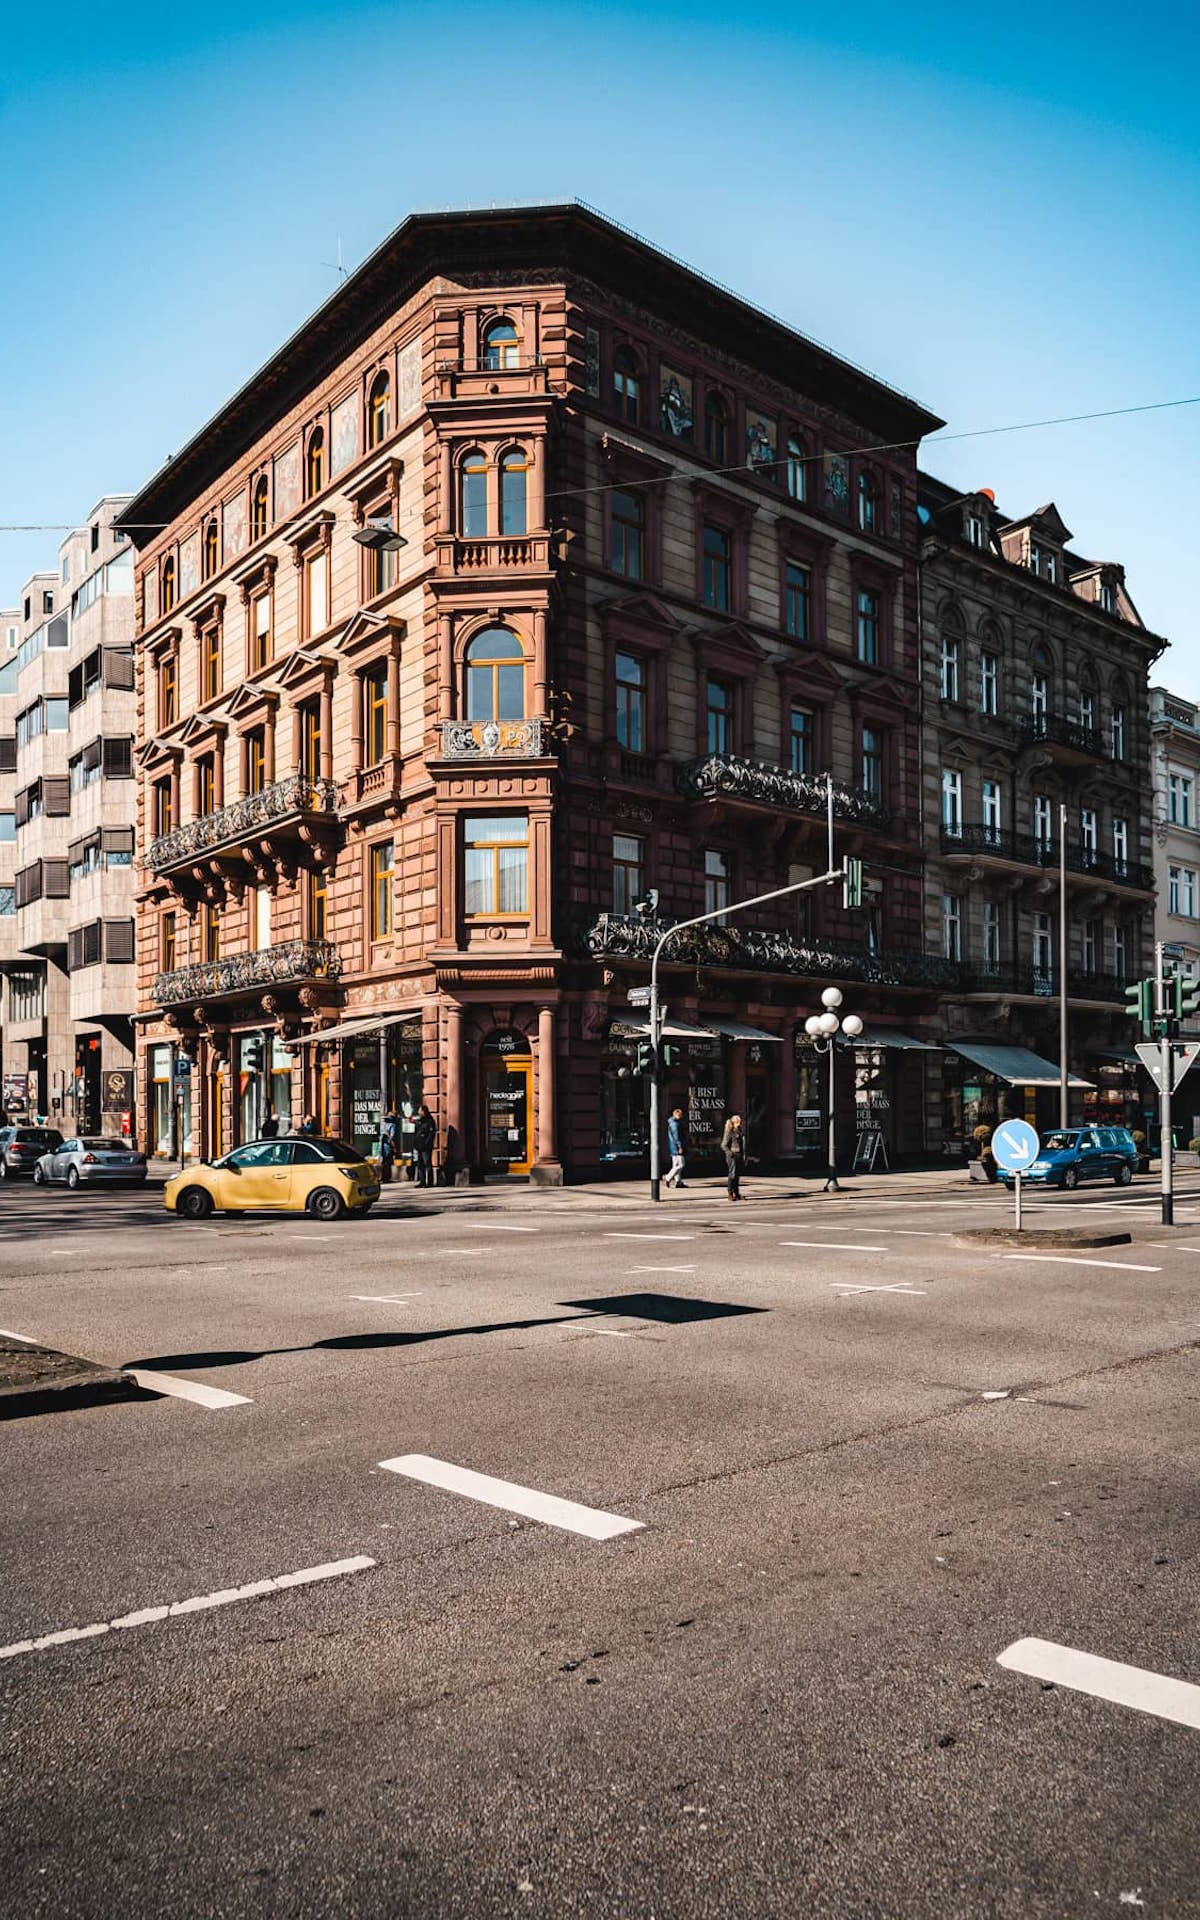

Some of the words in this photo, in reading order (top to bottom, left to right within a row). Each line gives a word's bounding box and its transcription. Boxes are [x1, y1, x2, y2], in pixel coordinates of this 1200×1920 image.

[178, 1061, 188, 1073] P
[697, 1087, 717, 1098] BIST
[354, 1101, 367, 1112] DAS
[367, 1101, 382, 1112] MAS
[689, 1099, 699, 1109] AS
[701, 1099, 725, 1109] MASS
[354, 1112, 369, 1123] DER
[689, 1111, 701, 1121] ER
[354, 1124, 378, 1135] DINGE.
[689, 1122, 714, 1133] INGE.
